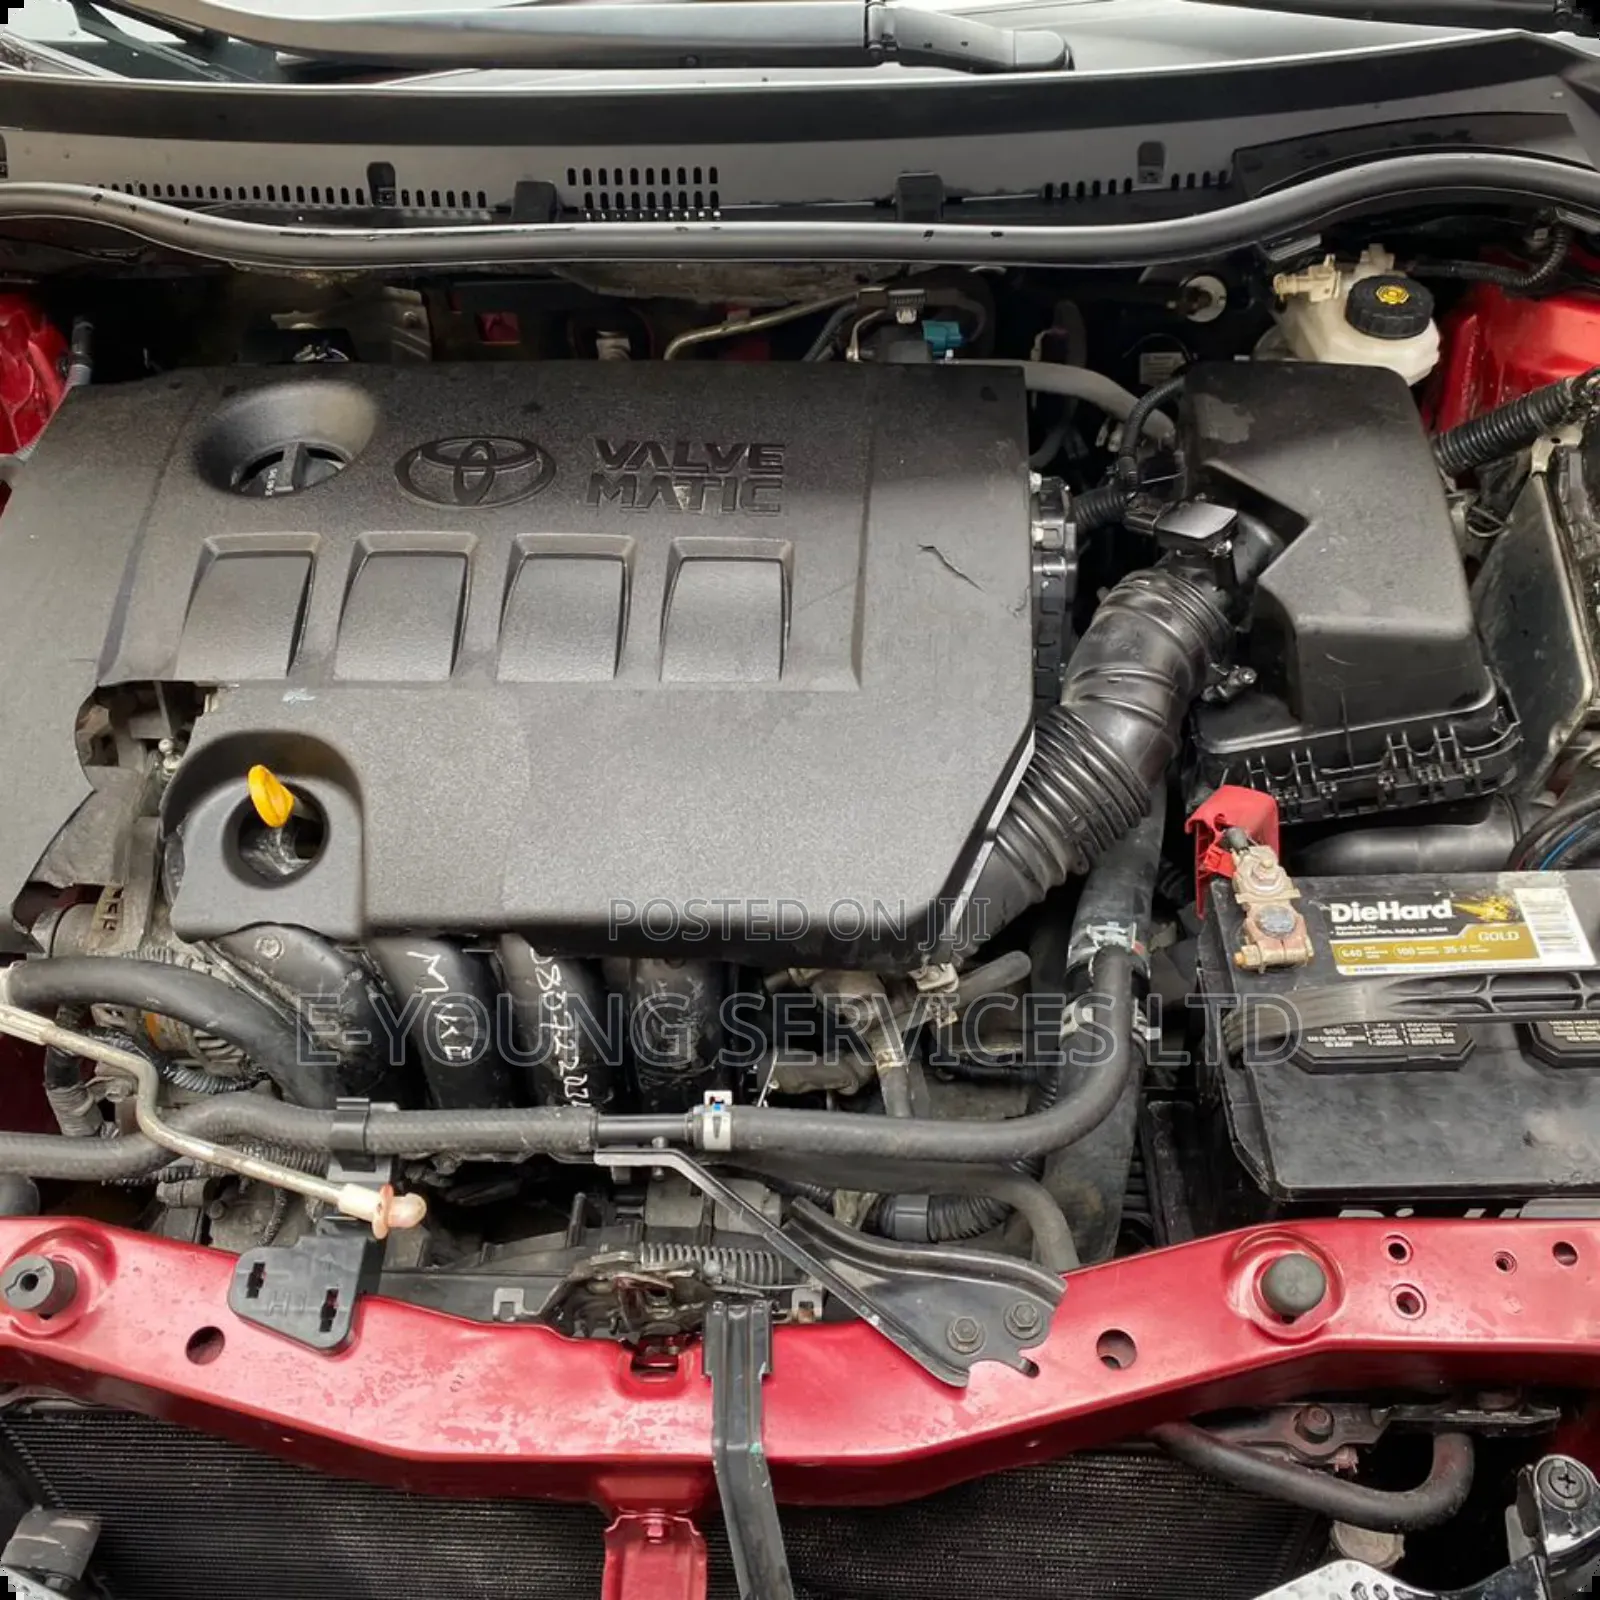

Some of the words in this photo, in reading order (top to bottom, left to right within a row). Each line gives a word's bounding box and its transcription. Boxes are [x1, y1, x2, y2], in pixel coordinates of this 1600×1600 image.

[592, 439, 786, 473] VALVE
[585, 472, 784, 514] MATIC
[1330, 898, 1453, 923] DieHard
[1478, 931, 1520, 942] GOLD
